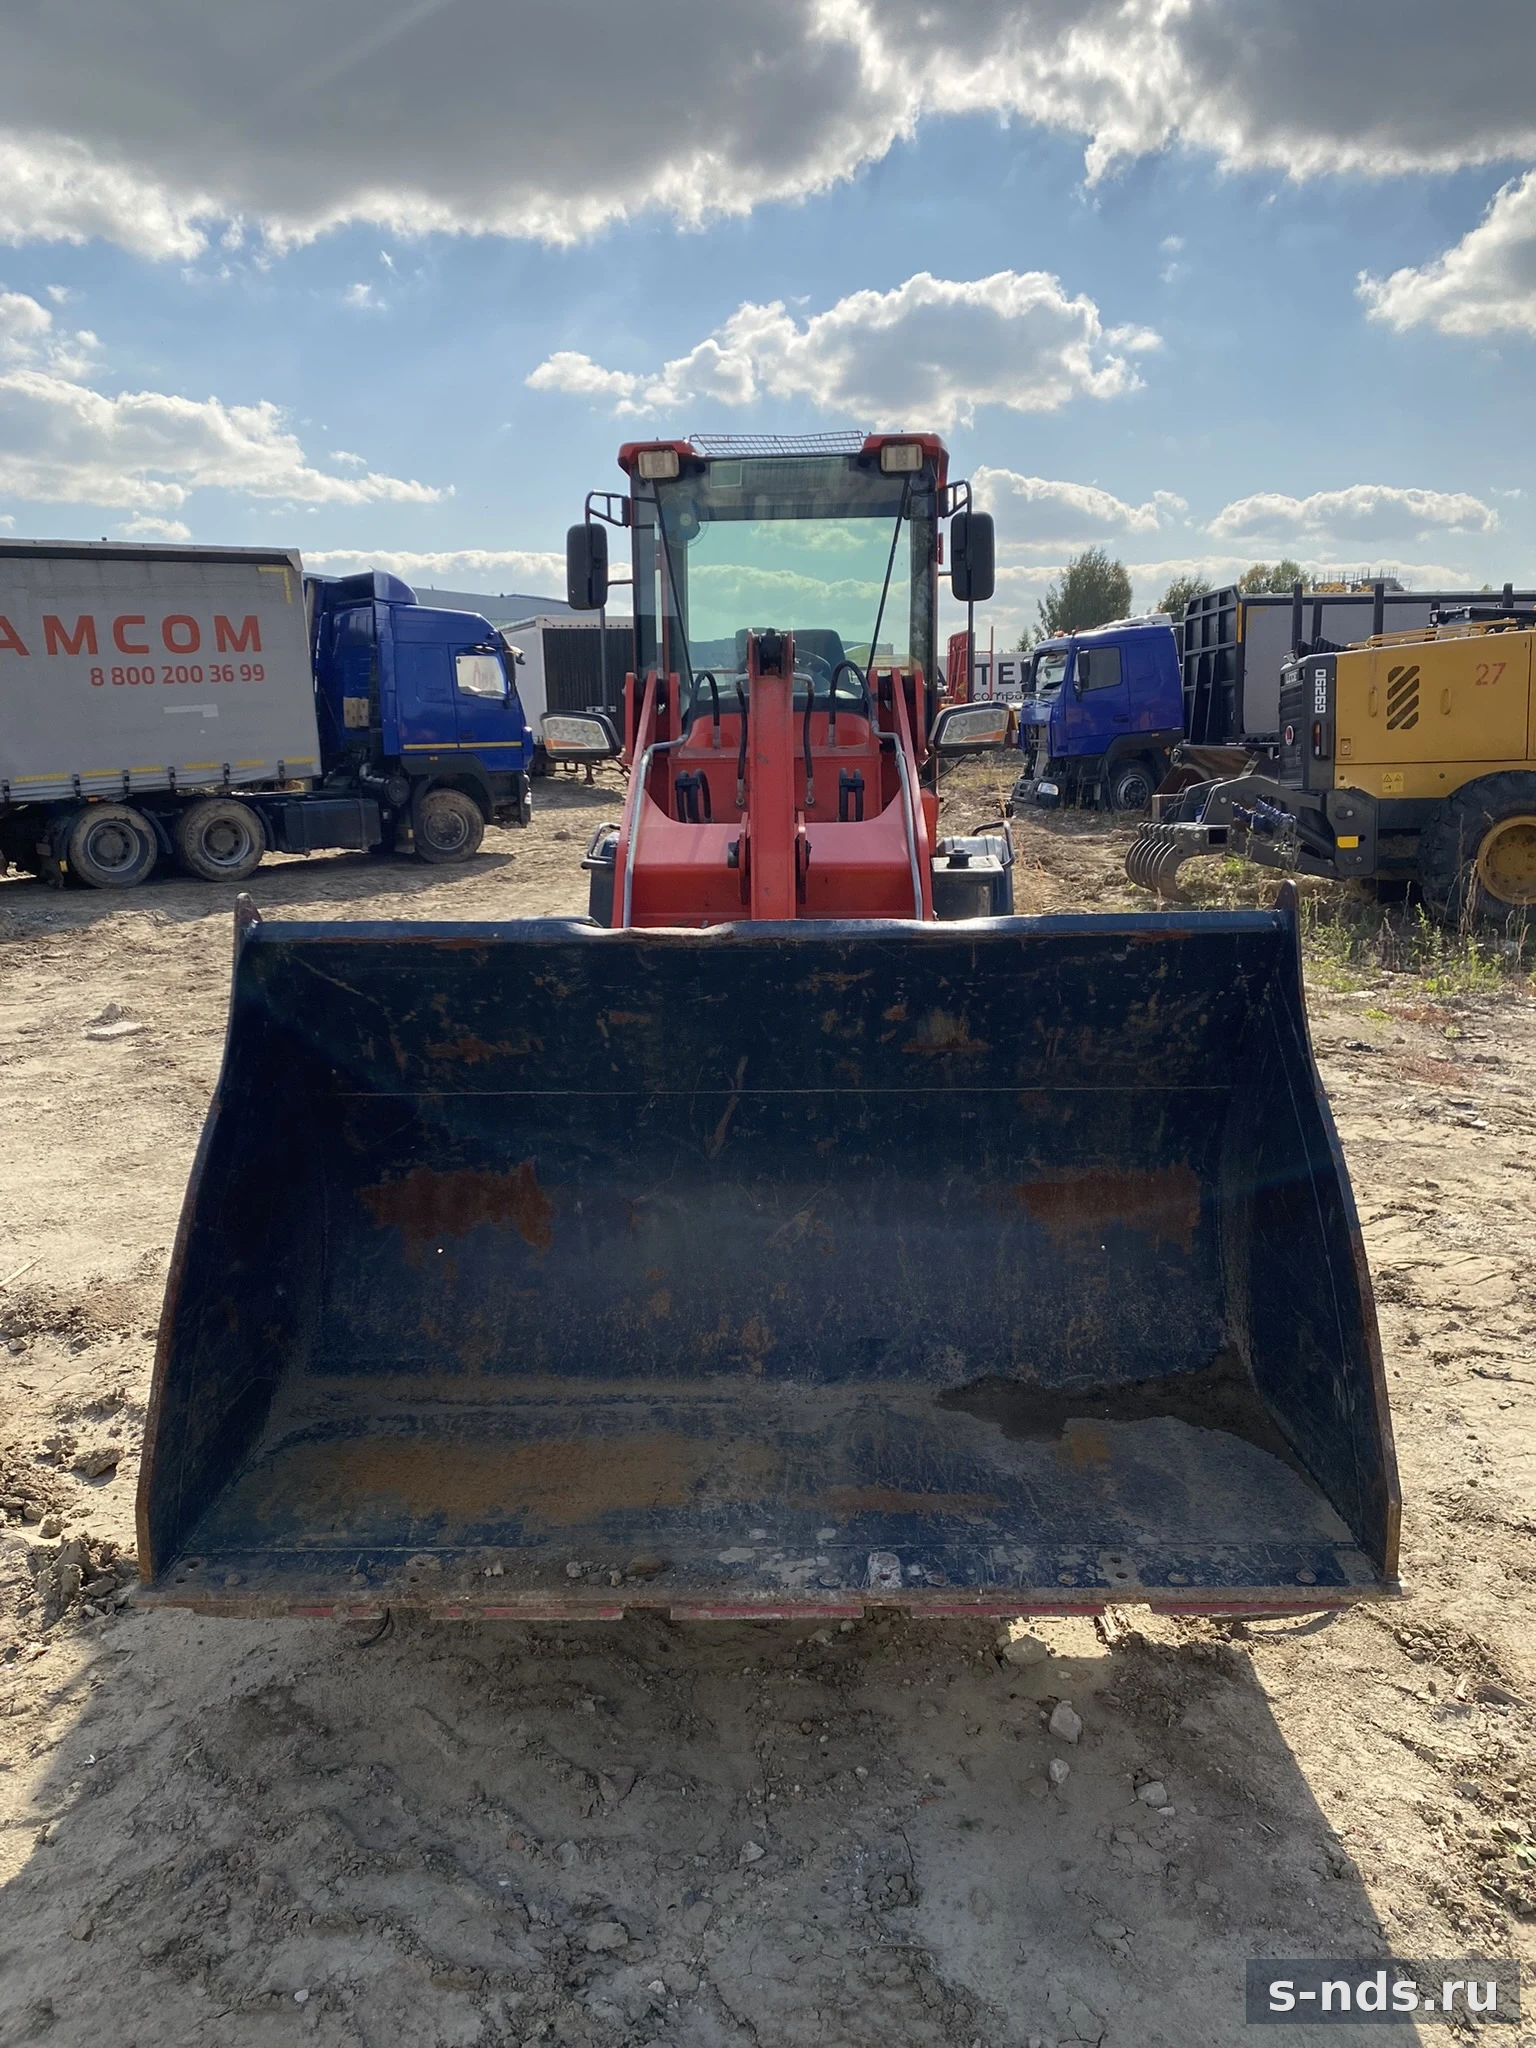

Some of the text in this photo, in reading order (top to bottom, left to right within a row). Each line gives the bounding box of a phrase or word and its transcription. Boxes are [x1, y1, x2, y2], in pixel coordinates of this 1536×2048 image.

[89, 663, 265, 686] 8 800 200 36 99
[1475, 662, 1507, 686] 27
[973, 691, 1028, 703] compa
[1314, 668, 1327, 714] G9290
